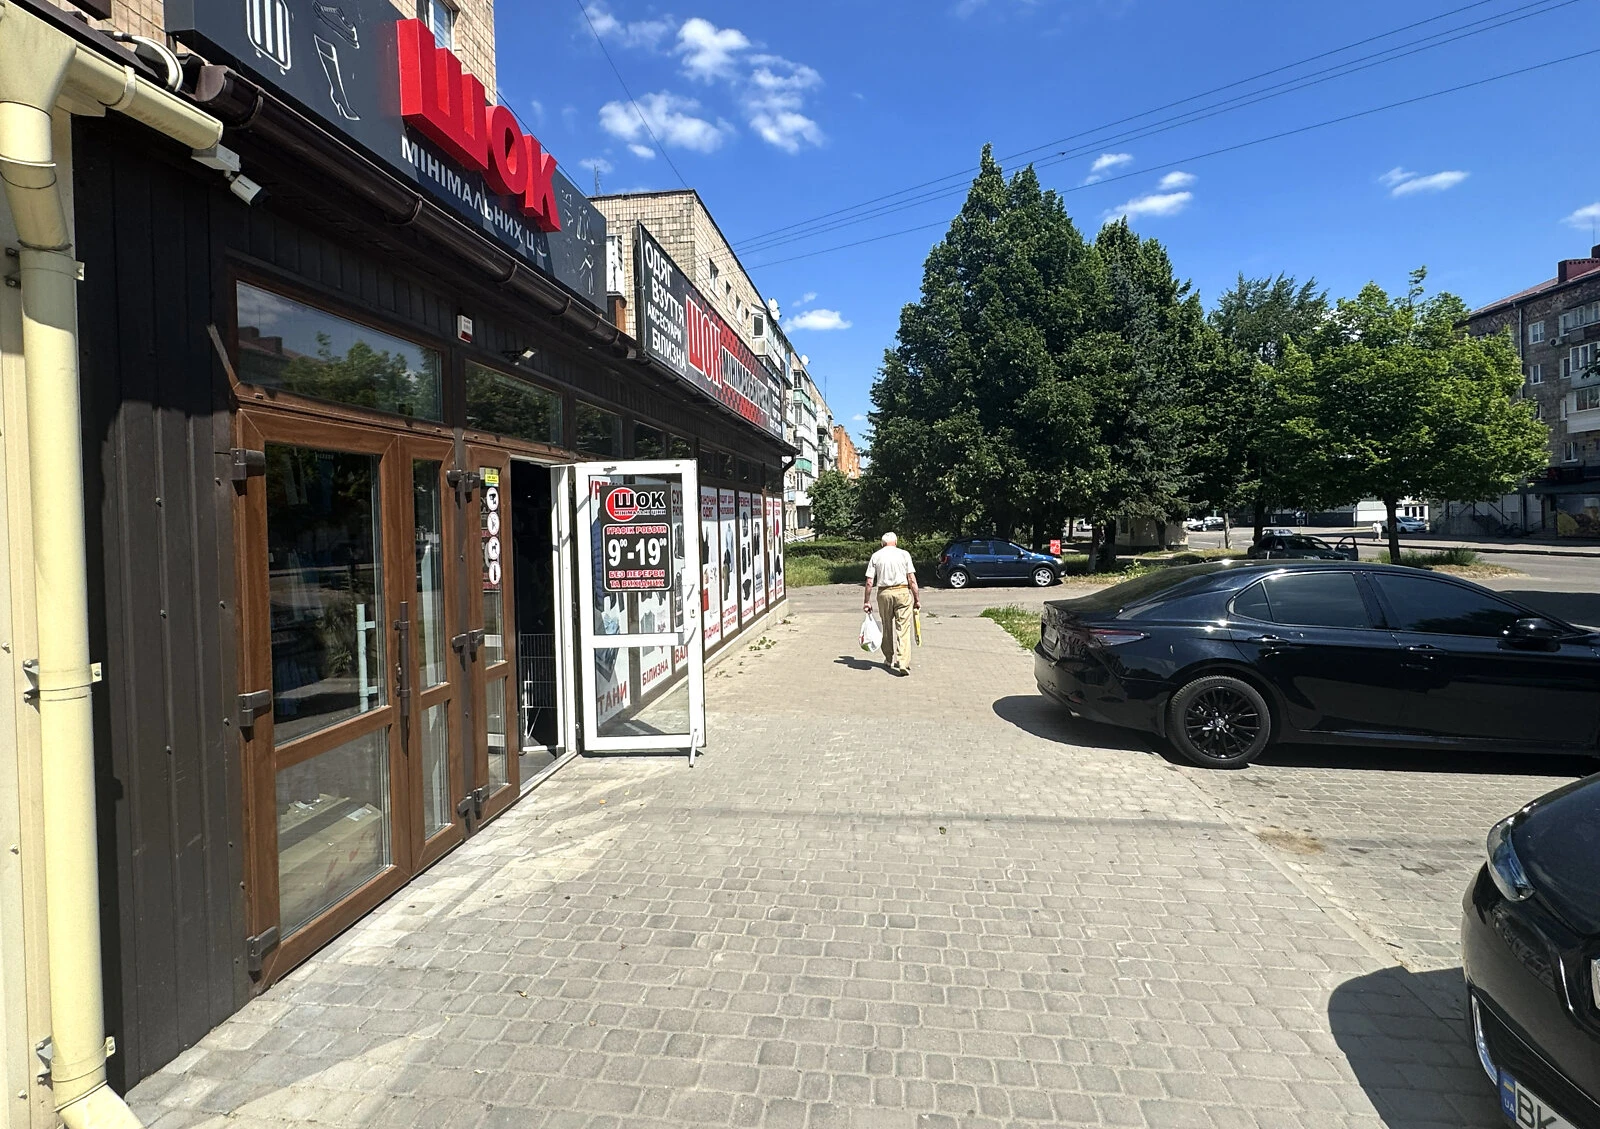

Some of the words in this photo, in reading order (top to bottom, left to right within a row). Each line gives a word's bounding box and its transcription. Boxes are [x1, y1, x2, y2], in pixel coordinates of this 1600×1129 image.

[397, 18, 561, 232] ШОК
[401, 134, 522, 244] МІНІМАЛЬНИХ
[645, 240, 673, 288] ОДЯГ
[651, 276, 684, 328] ВЗУТТЯ
[652, 327, 687, 372] БІЛИЗНА
[685, 293, 722, 389] ШОК
[613, 491, 667, 509] ШОК
[606, 526, 634, 535] ГРАФІК
[635, 525, 667, 535] РОБОТИ
[609, 570, 625, 578] БЕЗ
[626, 569, 665, 578] ПЕРЕРВИ
[610, 580, 620, 588] ТА
[674, 644, 688, 664] ВАЛ
[642, 658, 669, 687] БІЛИЗНА
[597, 681, 627, 716] ТАНИ
[1504, 1098, 1516, 1114] UA
